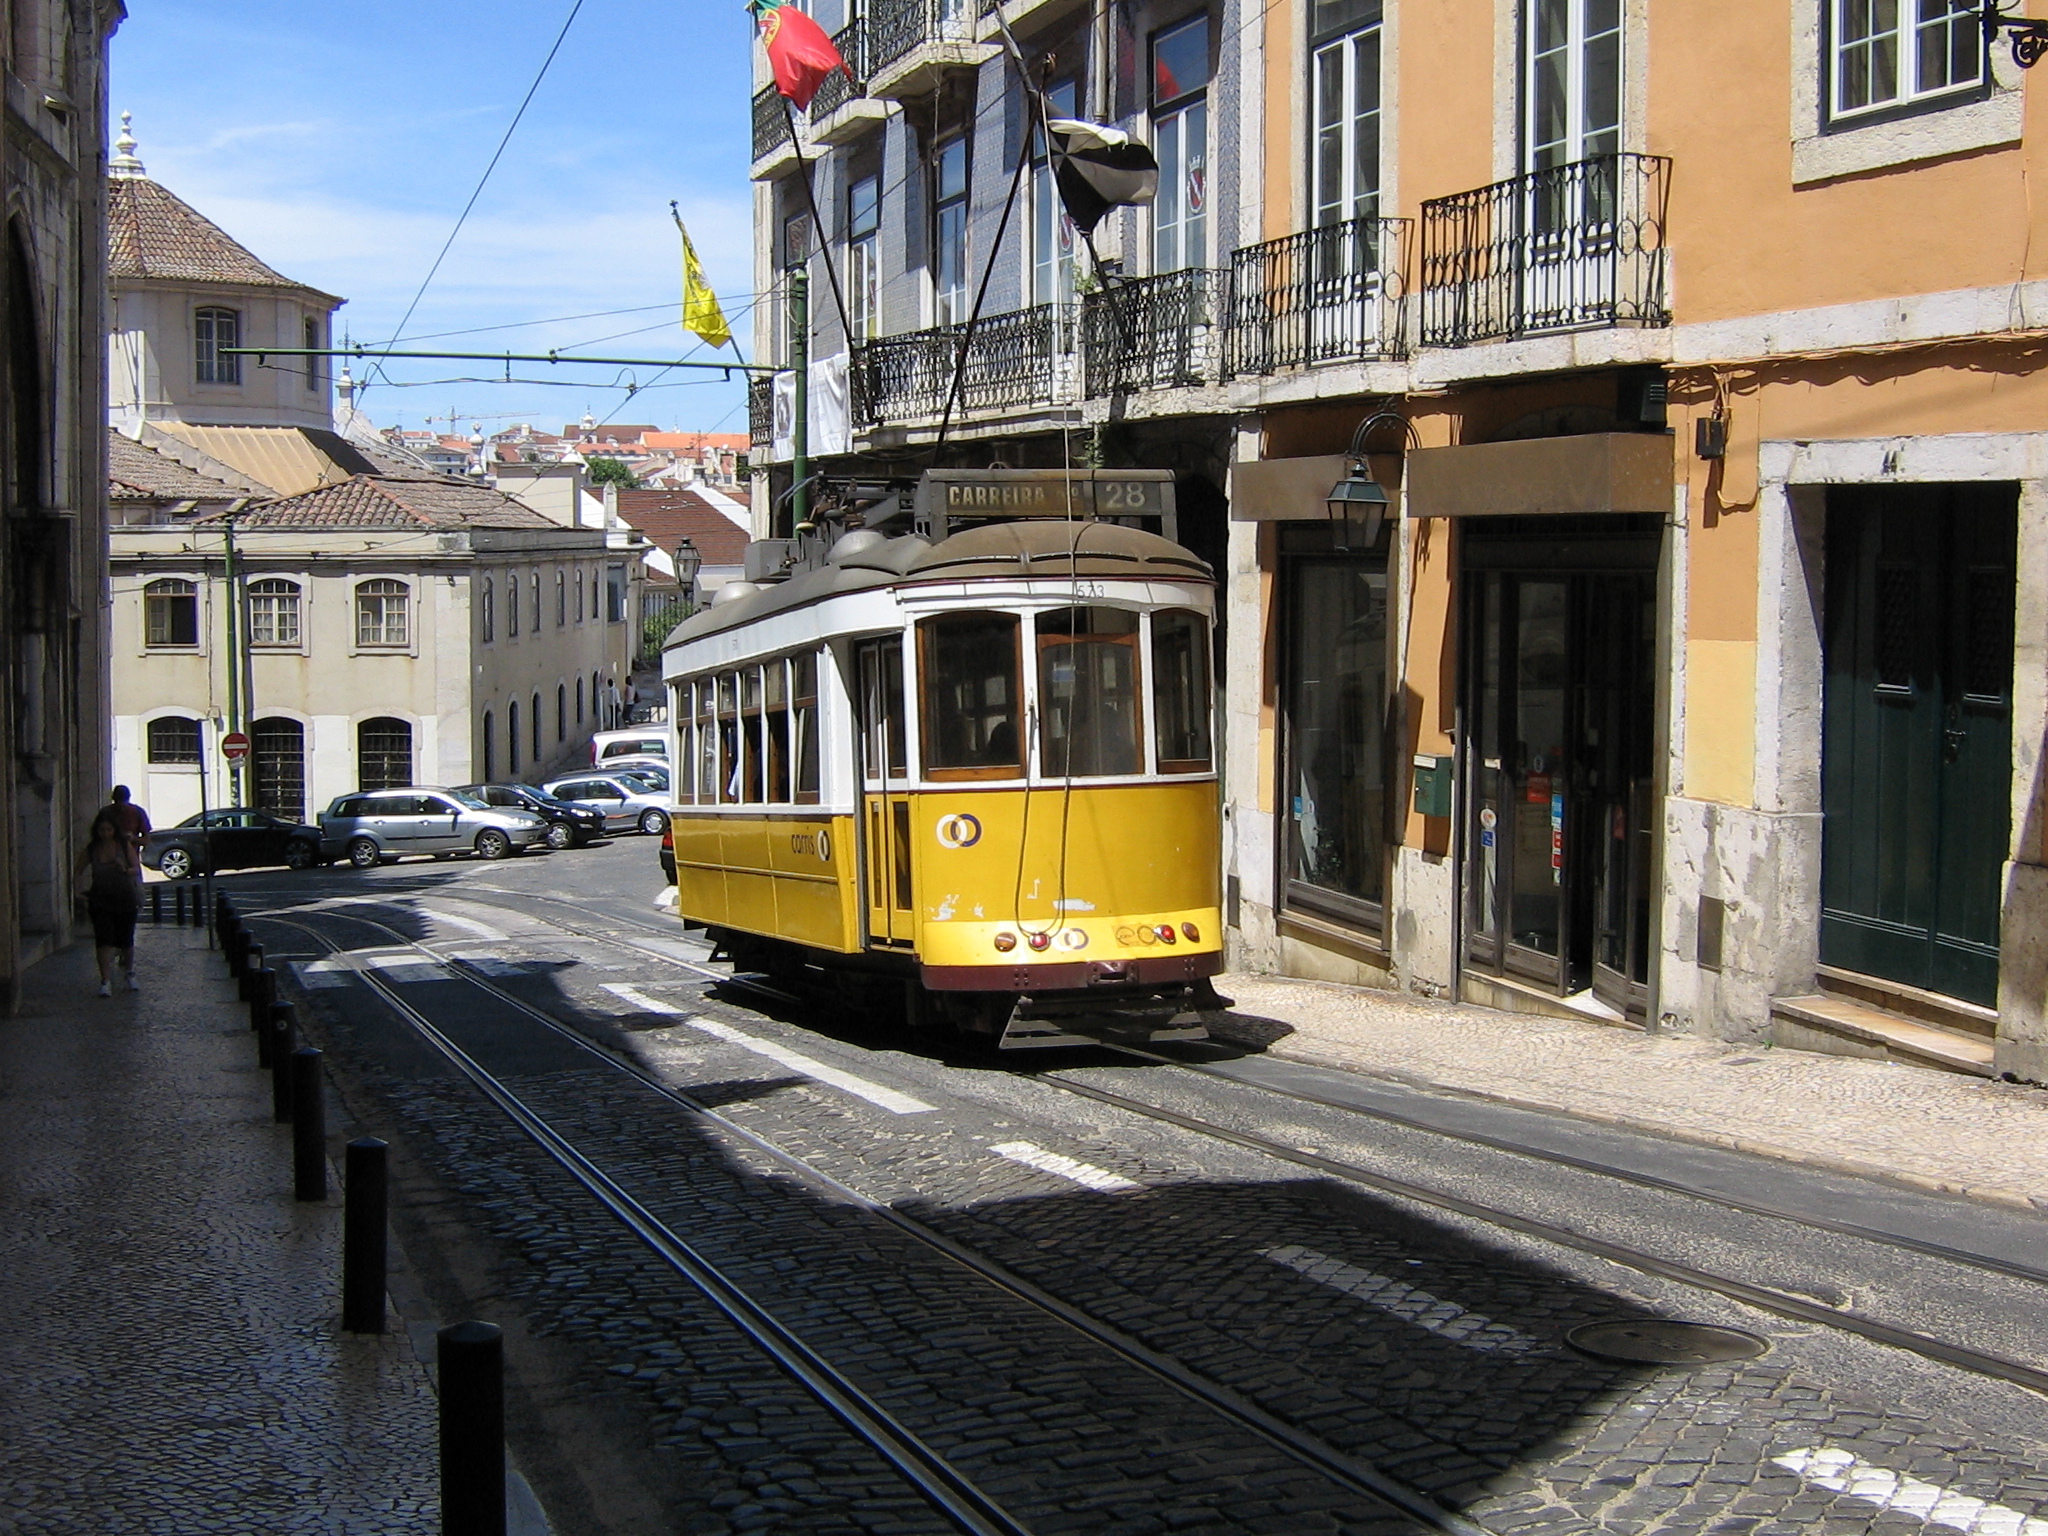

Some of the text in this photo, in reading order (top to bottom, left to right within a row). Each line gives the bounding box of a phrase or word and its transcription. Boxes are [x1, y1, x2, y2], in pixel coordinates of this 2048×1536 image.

[949, 486, 1044, 505] CARREIRA
[1106, 482, 1145, 507] 28
[1077, 584, 1105, 598] 573
